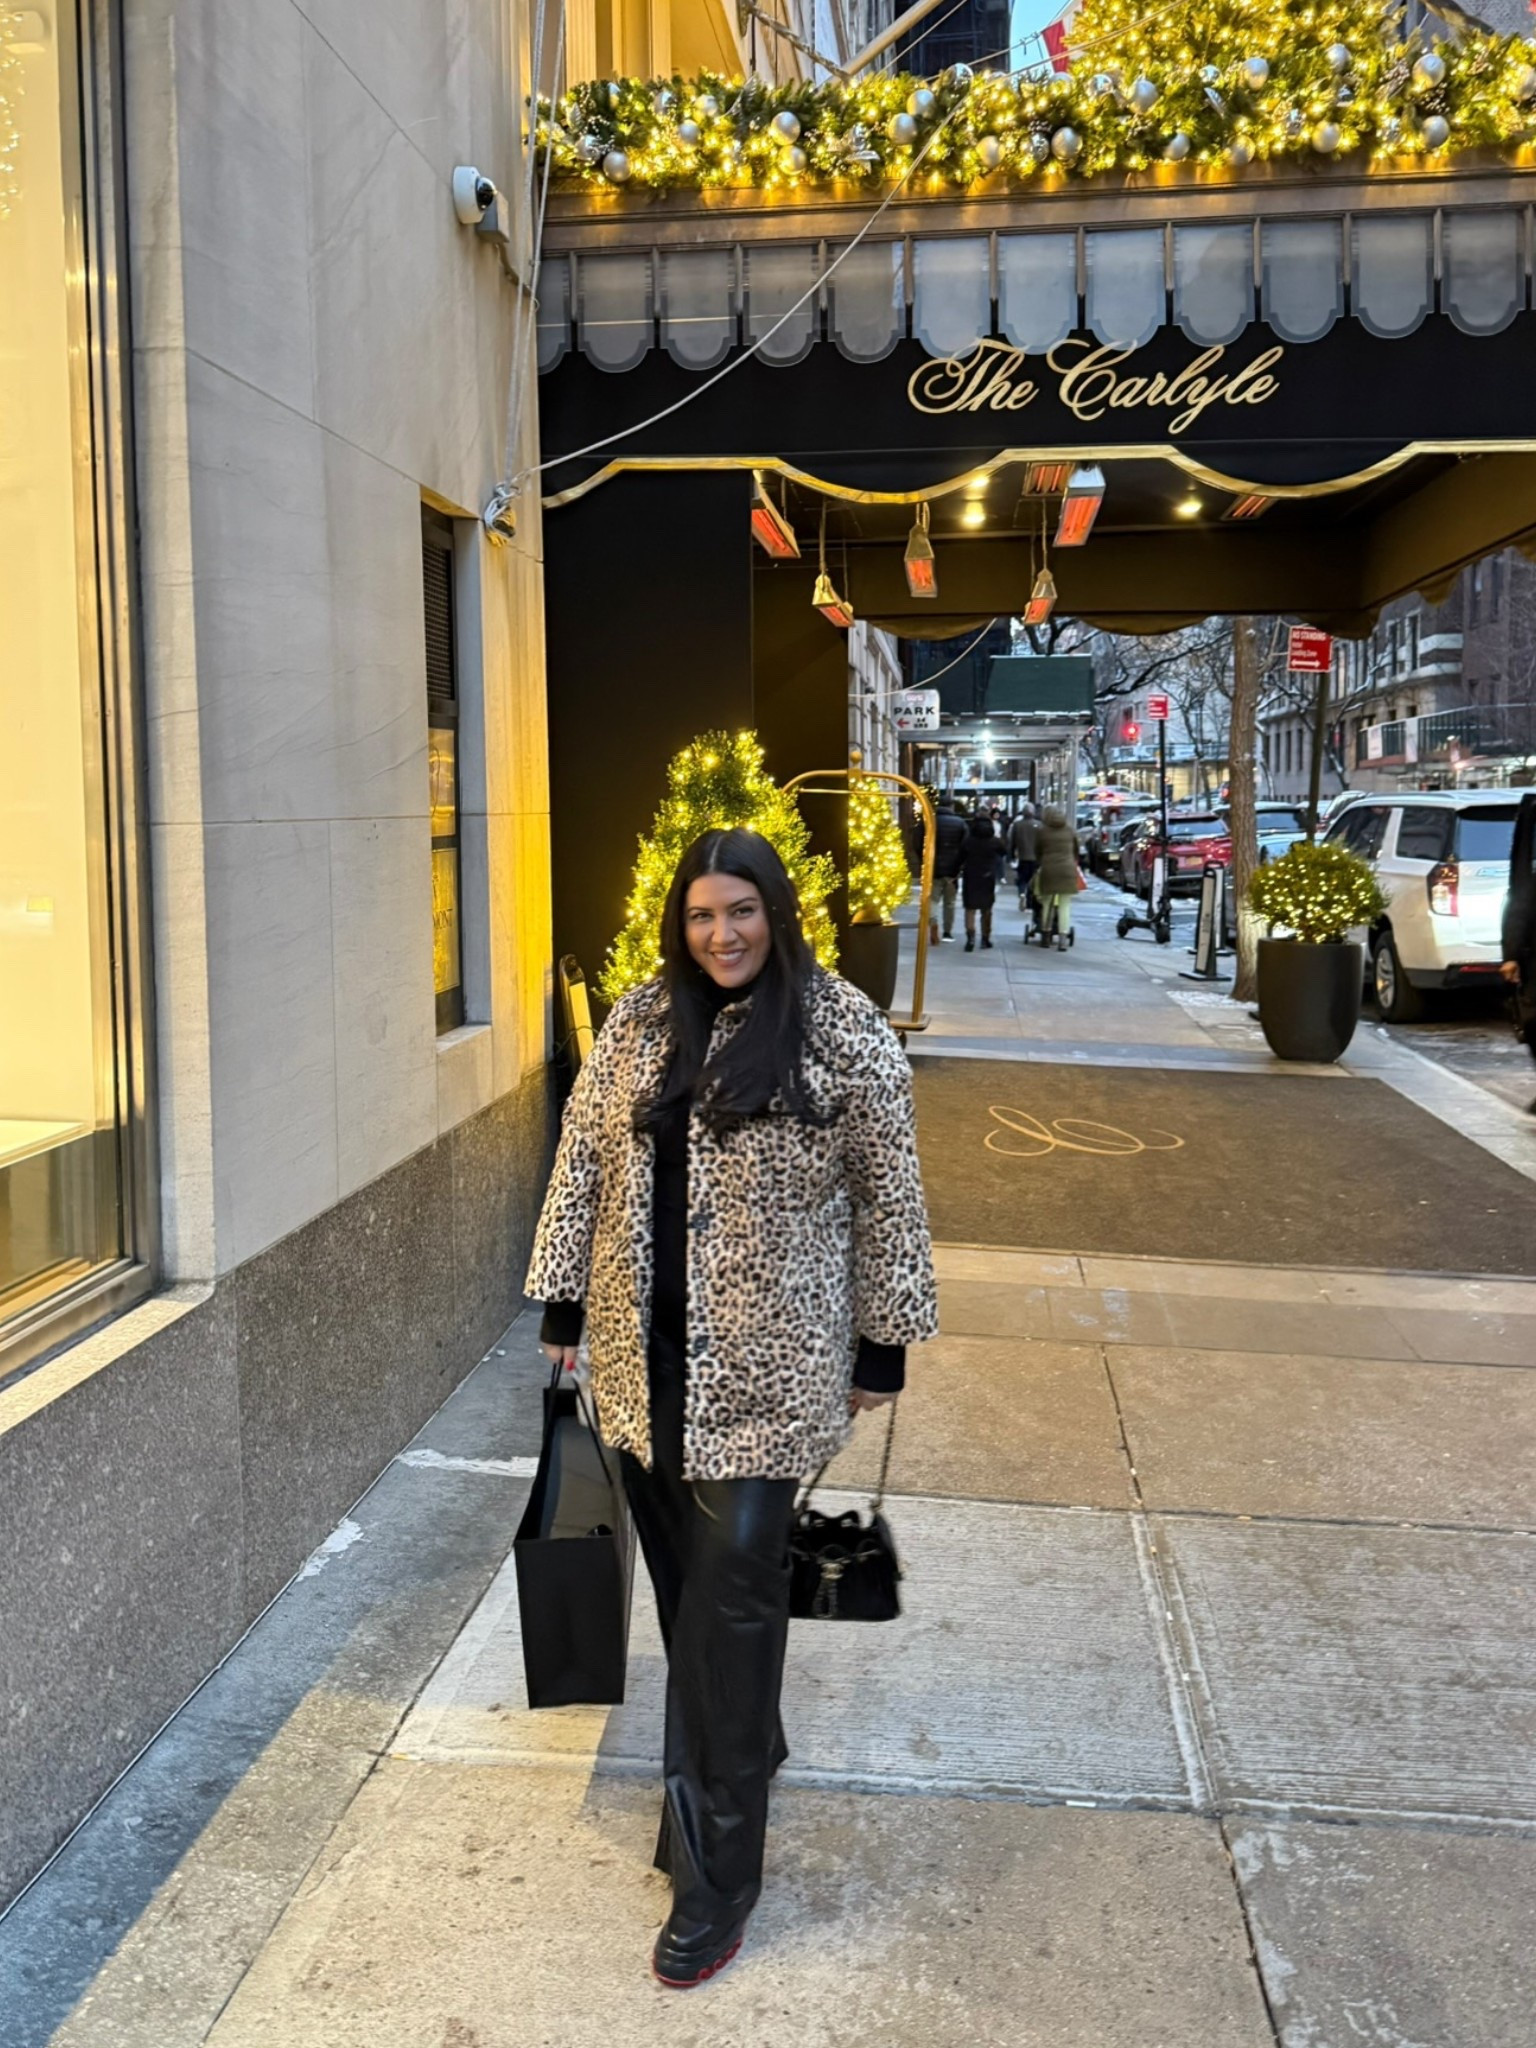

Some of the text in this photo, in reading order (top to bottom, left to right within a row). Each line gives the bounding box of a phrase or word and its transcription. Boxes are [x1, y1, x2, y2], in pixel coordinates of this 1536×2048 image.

[907, 338, 1284, 435] The Carlyle
[1292, 630, 1326, 641] NO STANDING
[894, 706, 935, 715] PARK
